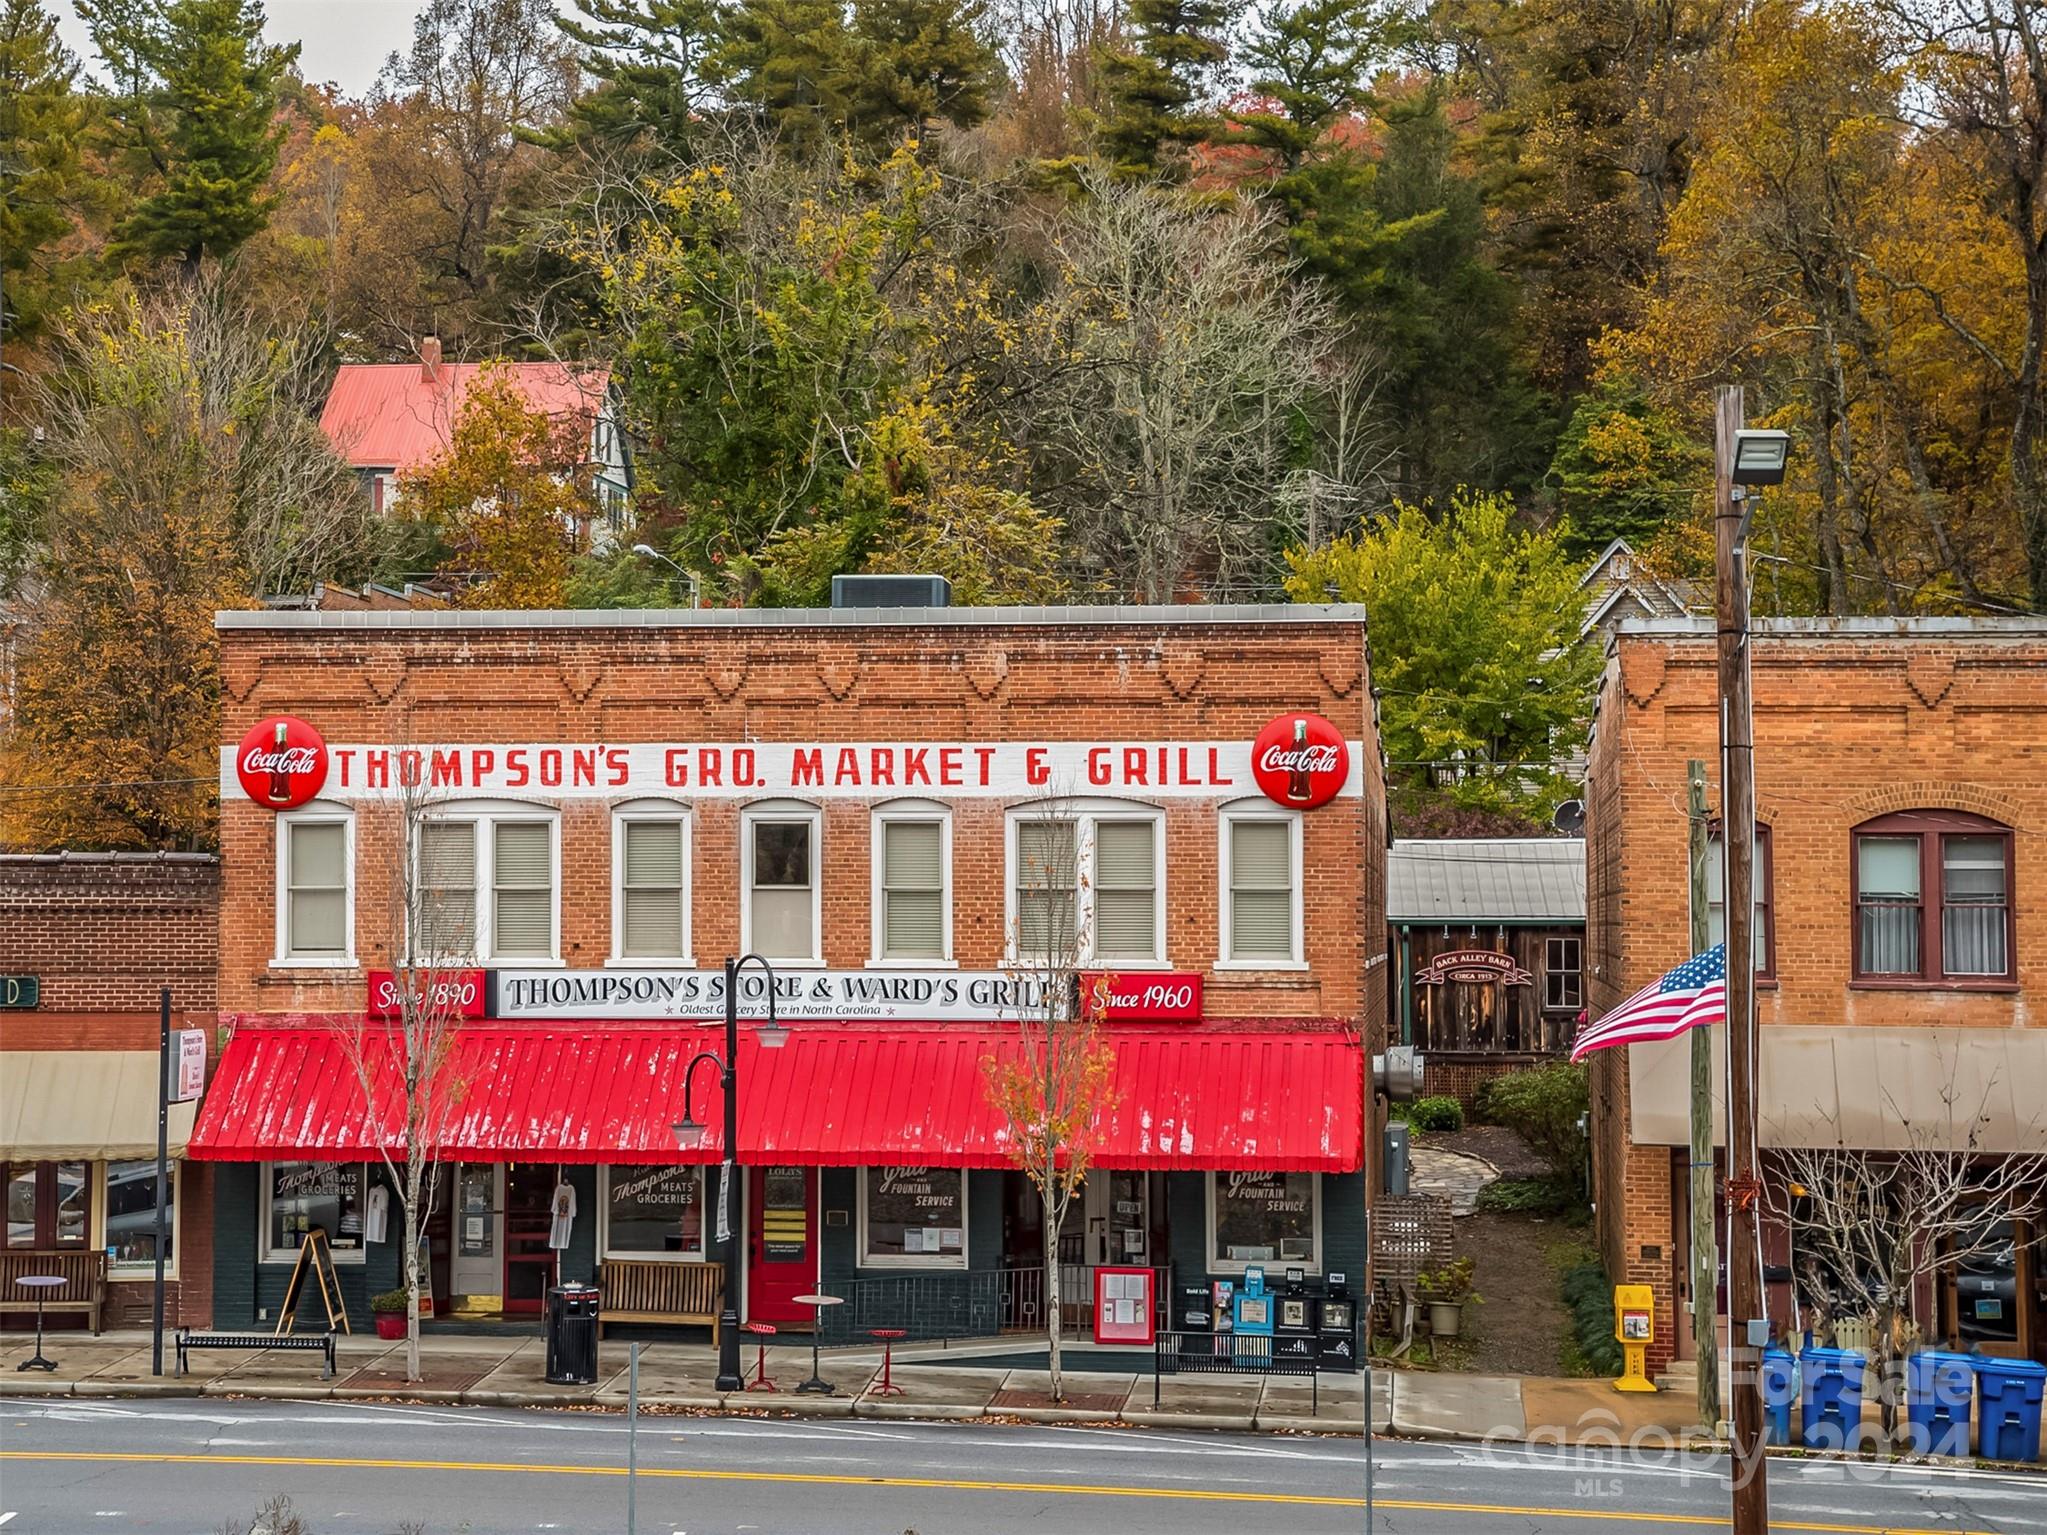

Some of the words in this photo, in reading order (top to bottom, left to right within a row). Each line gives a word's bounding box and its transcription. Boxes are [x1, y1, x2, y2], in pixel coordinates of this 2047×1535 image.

[242, 746, 319, 774] Coca-Cola
[1260, 745, 1339, 772] Coca-Cola
[335, 745, 630, 788] THOMPSON'S
[665, 748, 767, 788] GRO.
[791, 747, 996, 787] MARKET
[1026, 748, 1051, 786] &
[1088, 747, 1233, 786] GRILL
[1435, 955, 1458, 969] BACK
[1460, 953, 1487, 963] ALLEY
[1488, 955, 1512, 969] BARN
[8, 979, 19, 1004] D
[377, 981, 423, 1008] Sine
[509, 975, 699, 1007] THOMPSON'S
[709, 976, 803, 999] SORE
[812, 976, 834, 999] &
[844, 977, 959, 1002] WARD'S
[1091, 984, 1138, 1010] Since
[1142, 985, 1193, 1009] 1960
[680, 1004, 714, 1014] Oldest
[716, 1004, 758, 1017] Gcery
[760, 1004, 788, 1014] Stre
[789, 1004, 800, 1014] in
[802, 1004, 832, 1014] North
[836, 1004, 881, 1014] Carolina
[326, 1174, 357, 1183] MEATS
[301, 1185, 357, 1195] GROCERIES
[661, 1182, 693, 1192] MEATS
[891, 1183, 931, 1194] FOUNTAIN
[1239, 1188, 1285, 1199] FOUNTAIN
[637, 1194, 693, 1204] GROCERIES
[915, 1196, 954, 1206] SERVICE
[1266, 1200, 1305, 1211] SERVICE
